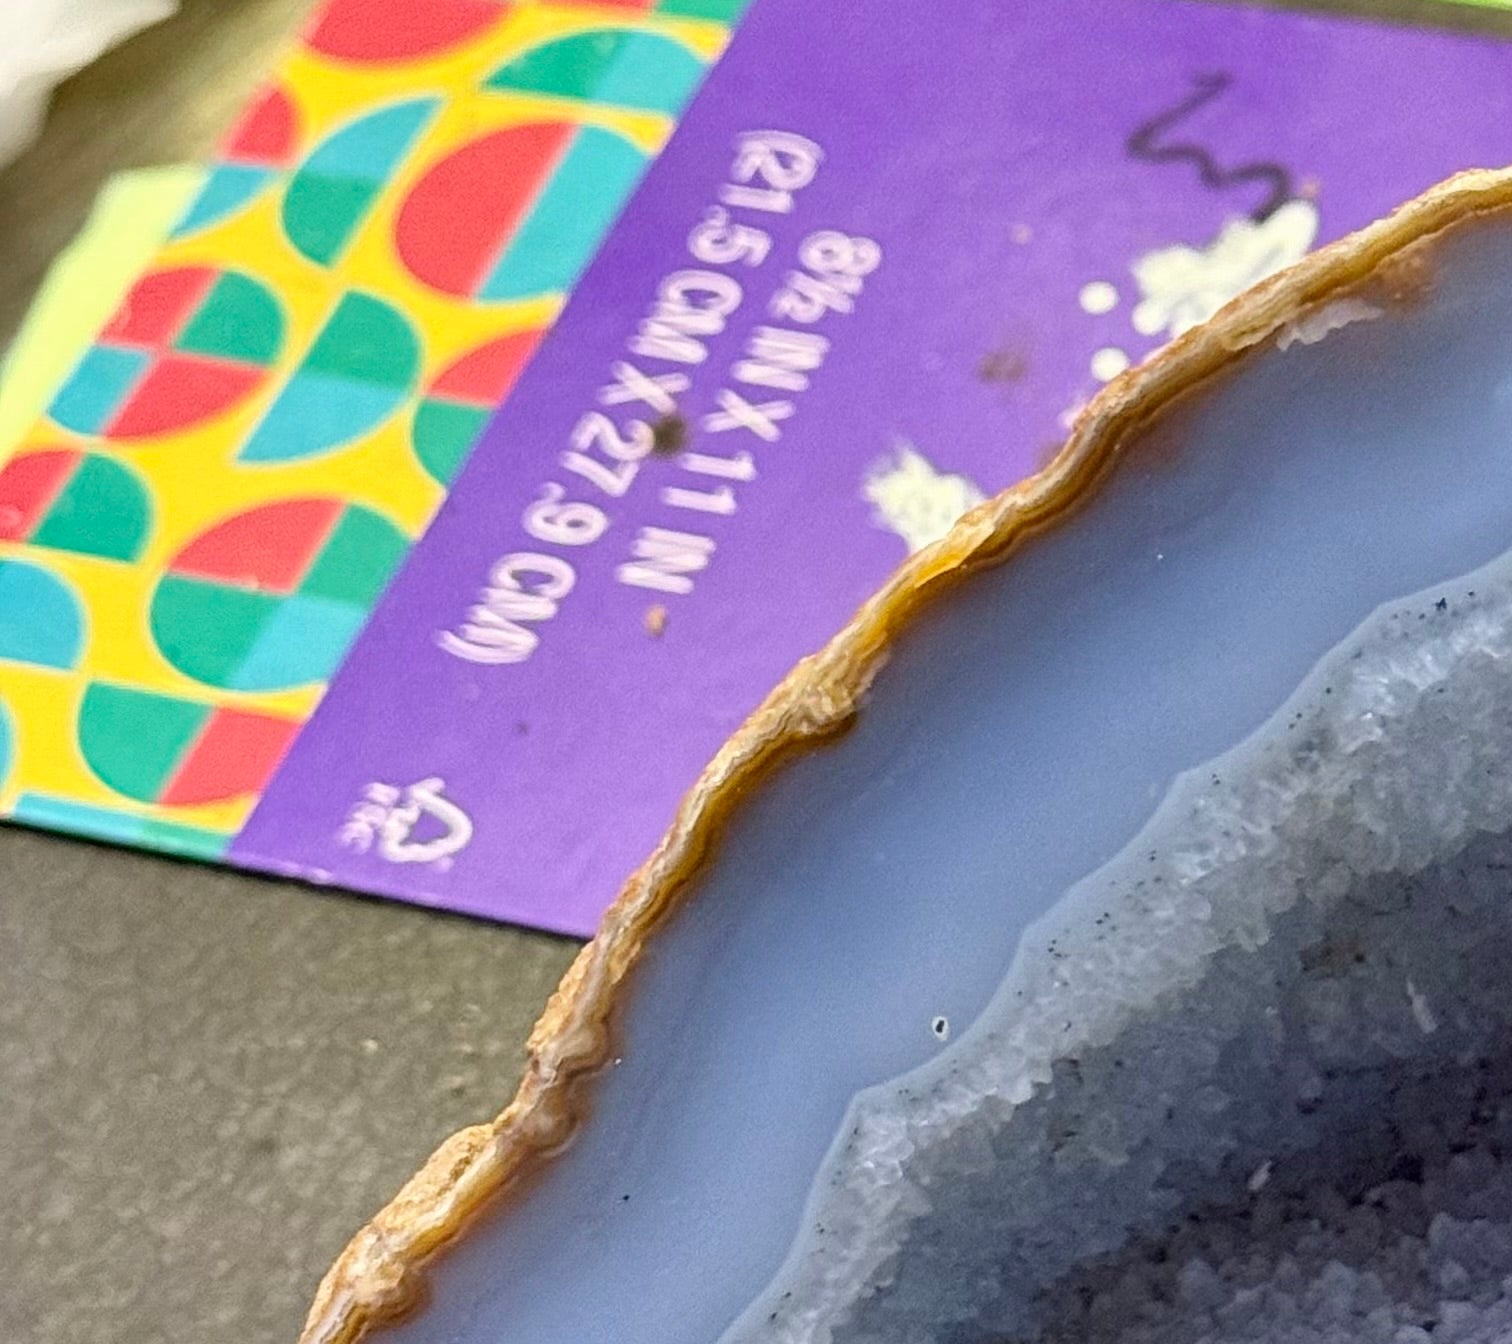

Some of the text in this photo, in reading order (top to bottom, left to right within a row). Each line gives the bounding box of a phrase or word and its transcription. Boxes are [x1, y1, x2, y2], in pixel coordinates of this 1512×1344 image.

[630, 270, 742, 362] CM
[602, 362, 692, 413] X
[734, 327, 830, 390] IN
[704, 389, 796, 443] X
[524, 413, 654, 546] 27.9
[662, 453, 756, 513] 11
[616, 525, 717, 594] IN
[438, 553, 576, 662] CM)
